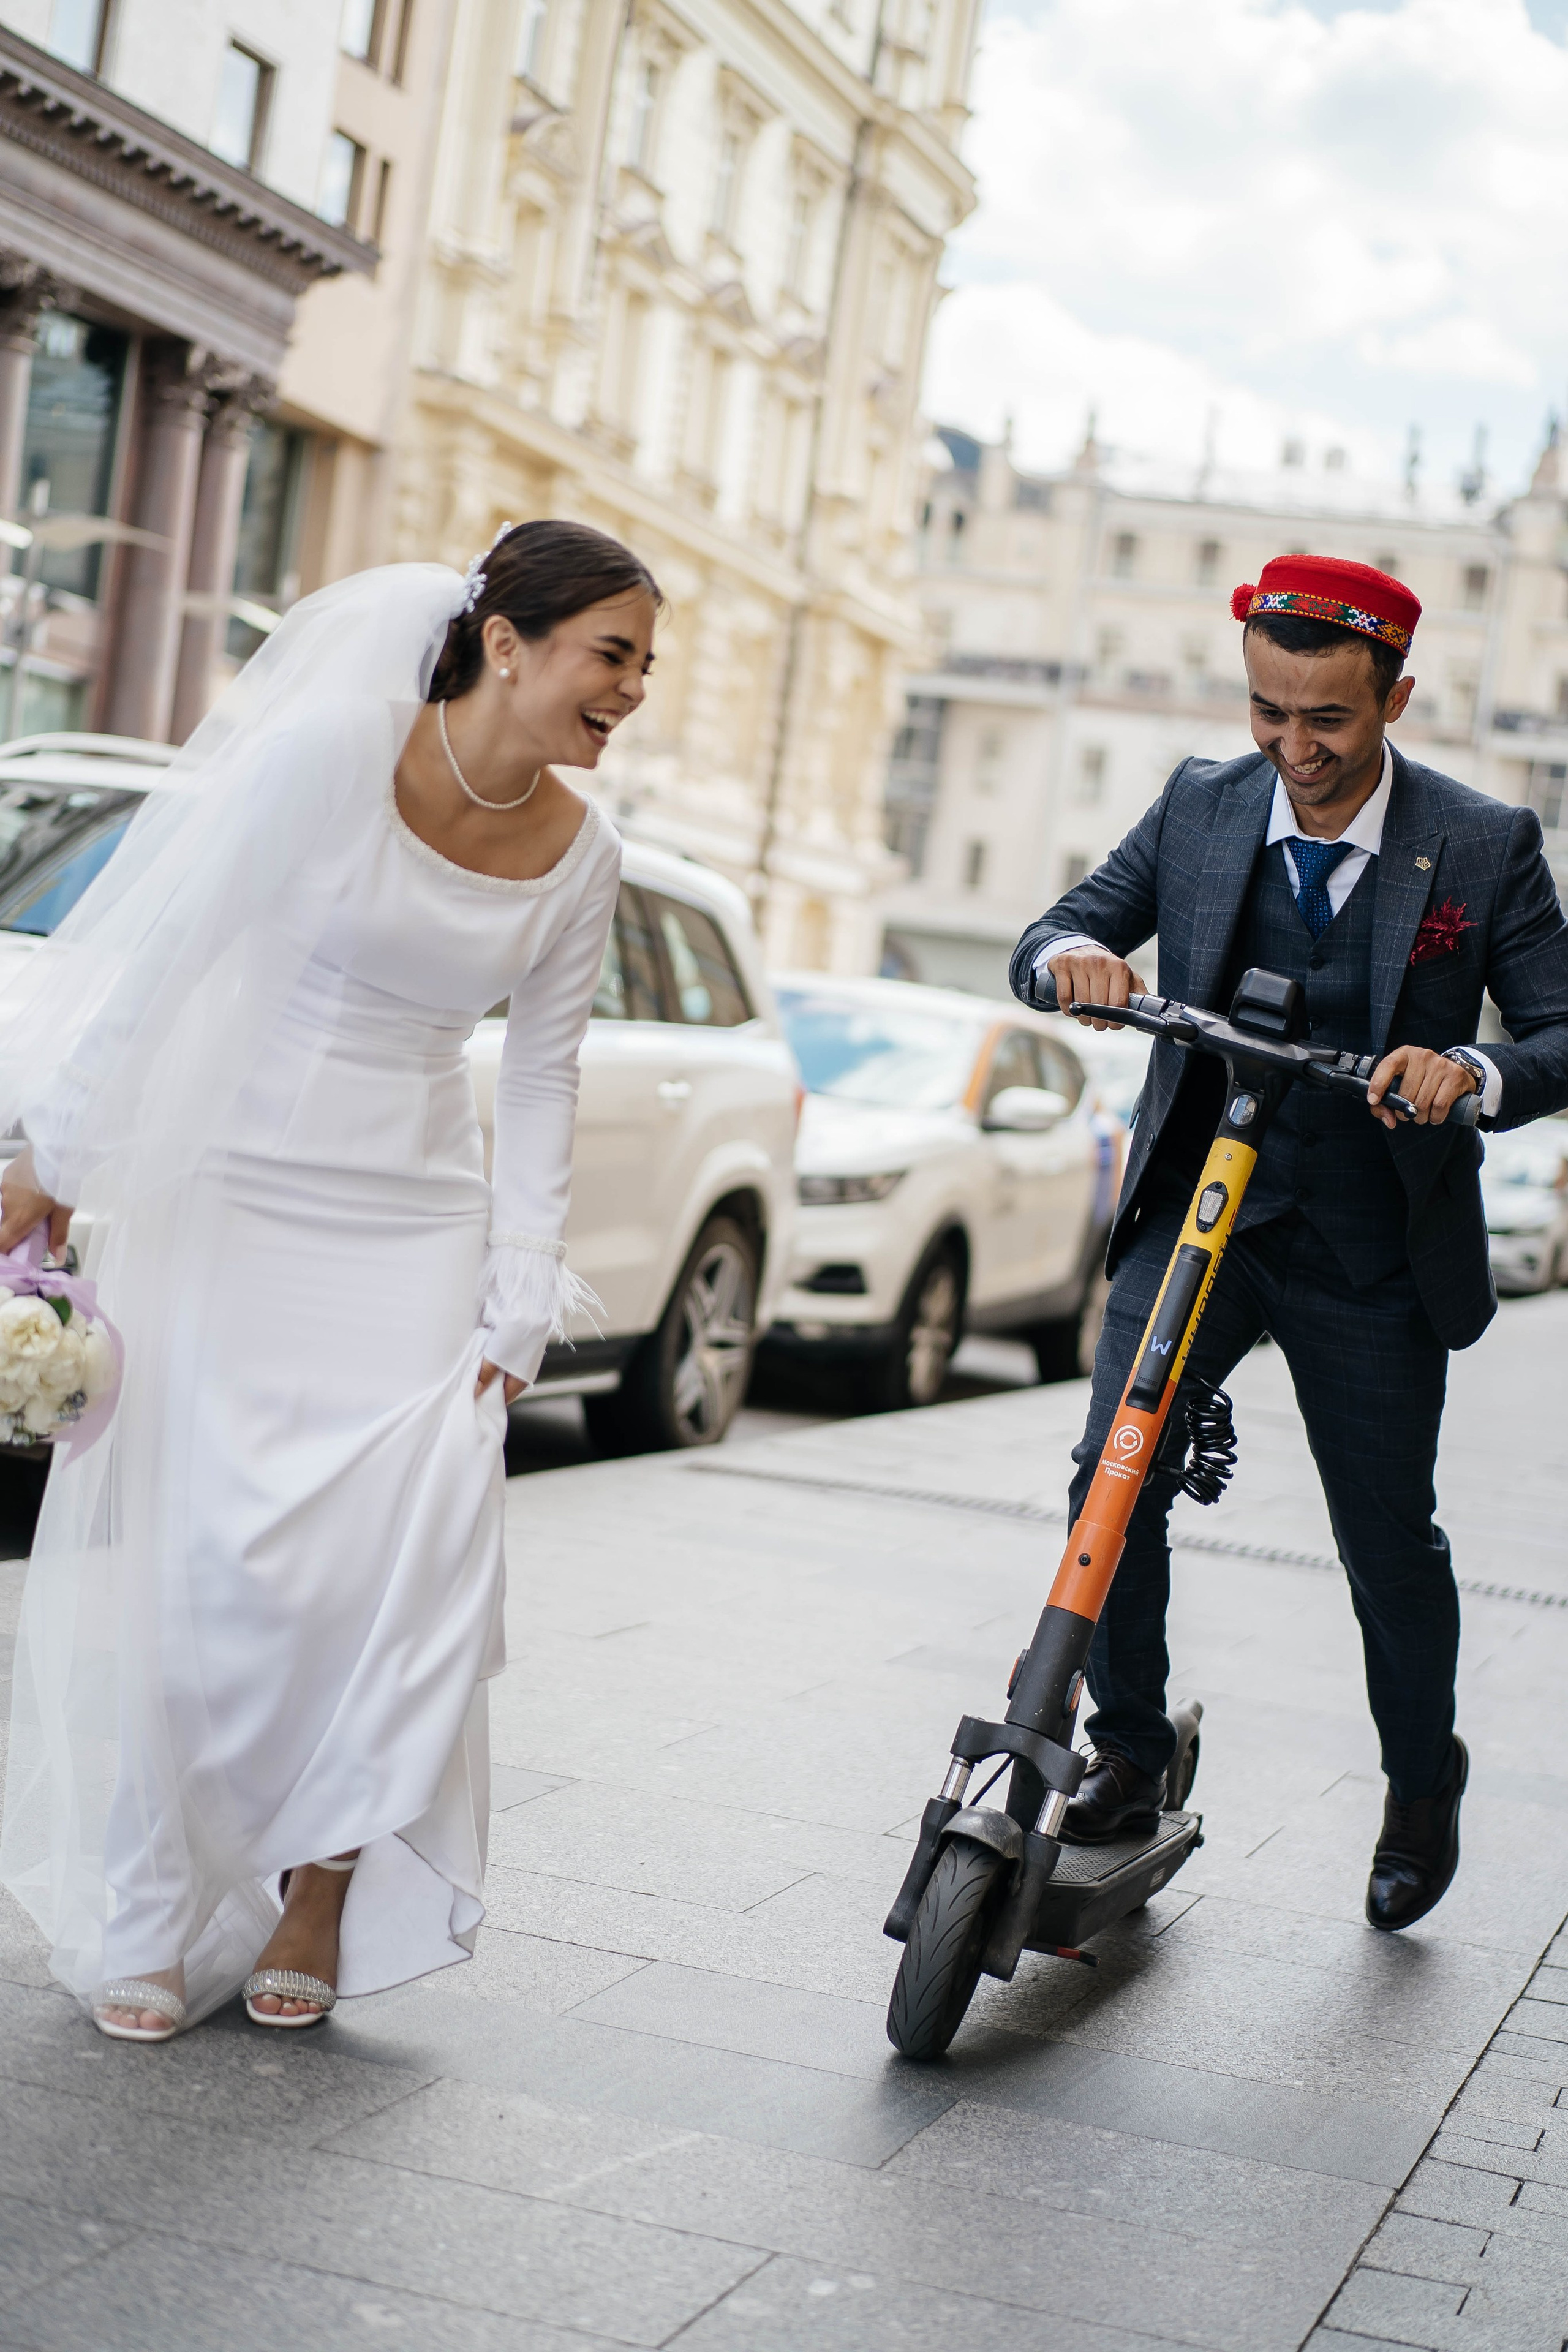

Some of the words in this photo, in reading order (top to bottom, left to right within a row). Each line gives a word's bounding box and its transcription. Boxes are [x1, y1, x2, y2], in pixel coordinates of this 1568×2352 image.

[1151, 1335, 1172, 1355] W
[1101, 1458, 1139, 1476] Московский
[1104, 1467, 1131, 1480] Прокат
